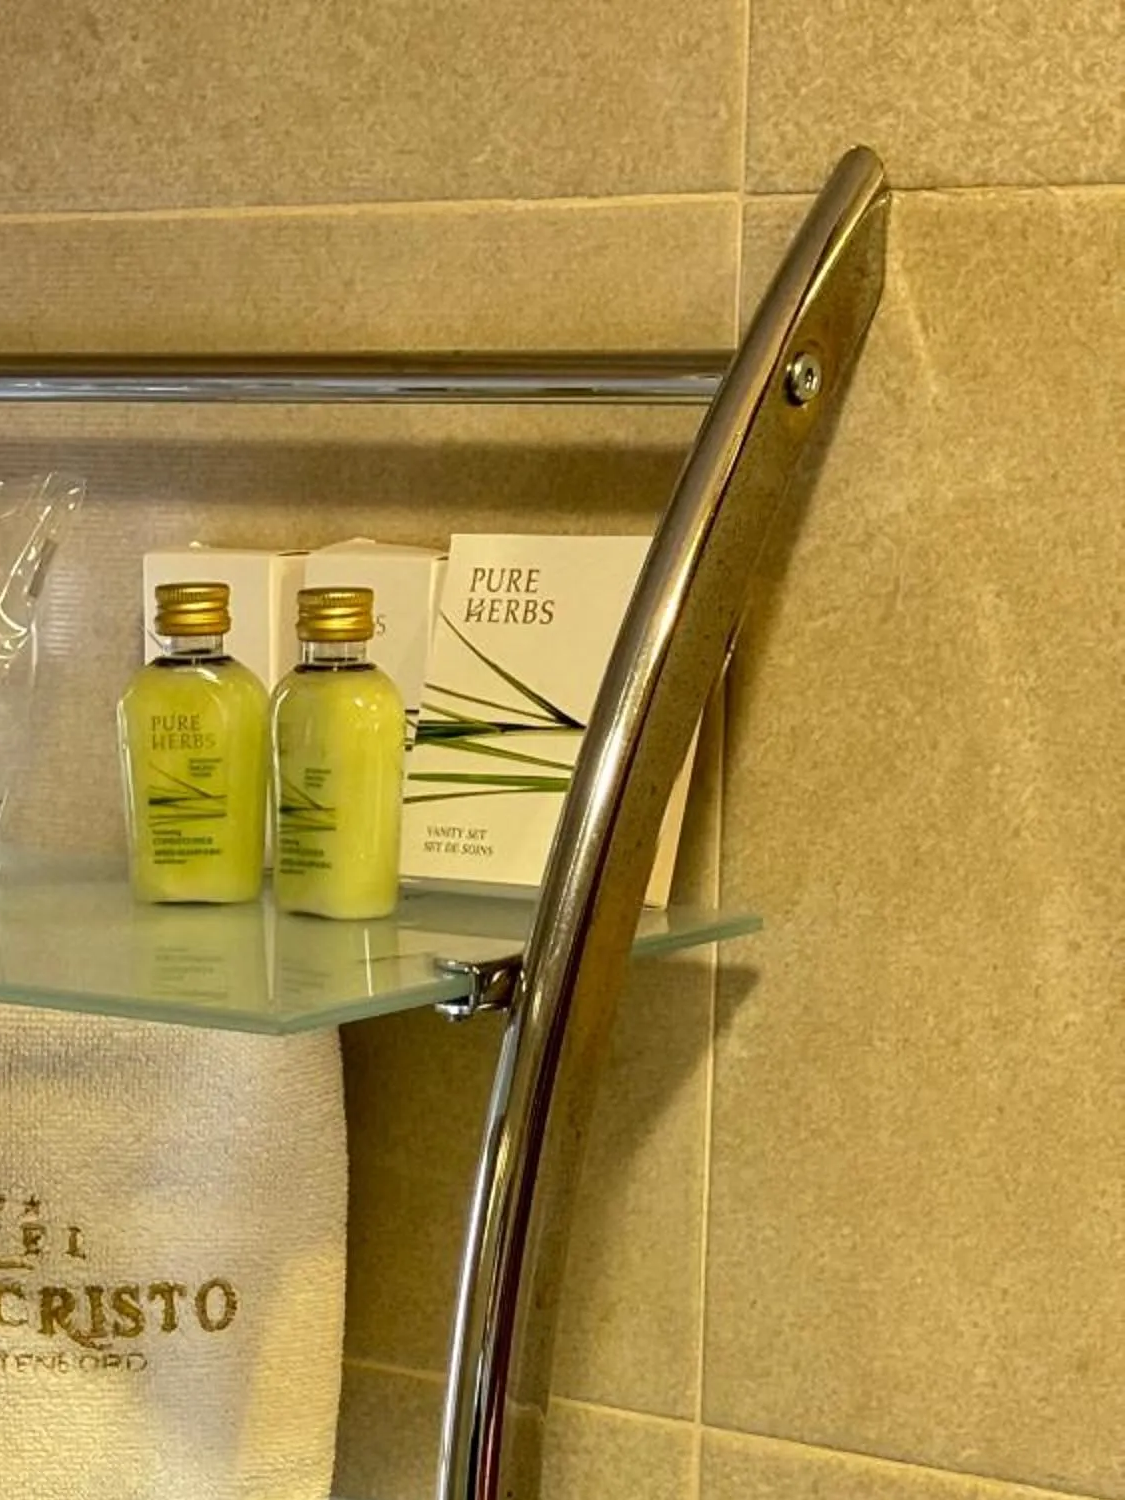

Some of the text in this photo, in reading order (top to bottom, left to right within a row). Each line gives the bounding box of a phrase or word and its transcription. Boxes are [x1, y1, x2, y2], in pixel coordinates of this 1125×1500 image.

[469, 566, 540, 593] PURE
[464, 597, 556, 625] HERBS
[151, 714, 201, 731] PURE
[152, 733, 216, 750] HERBS
